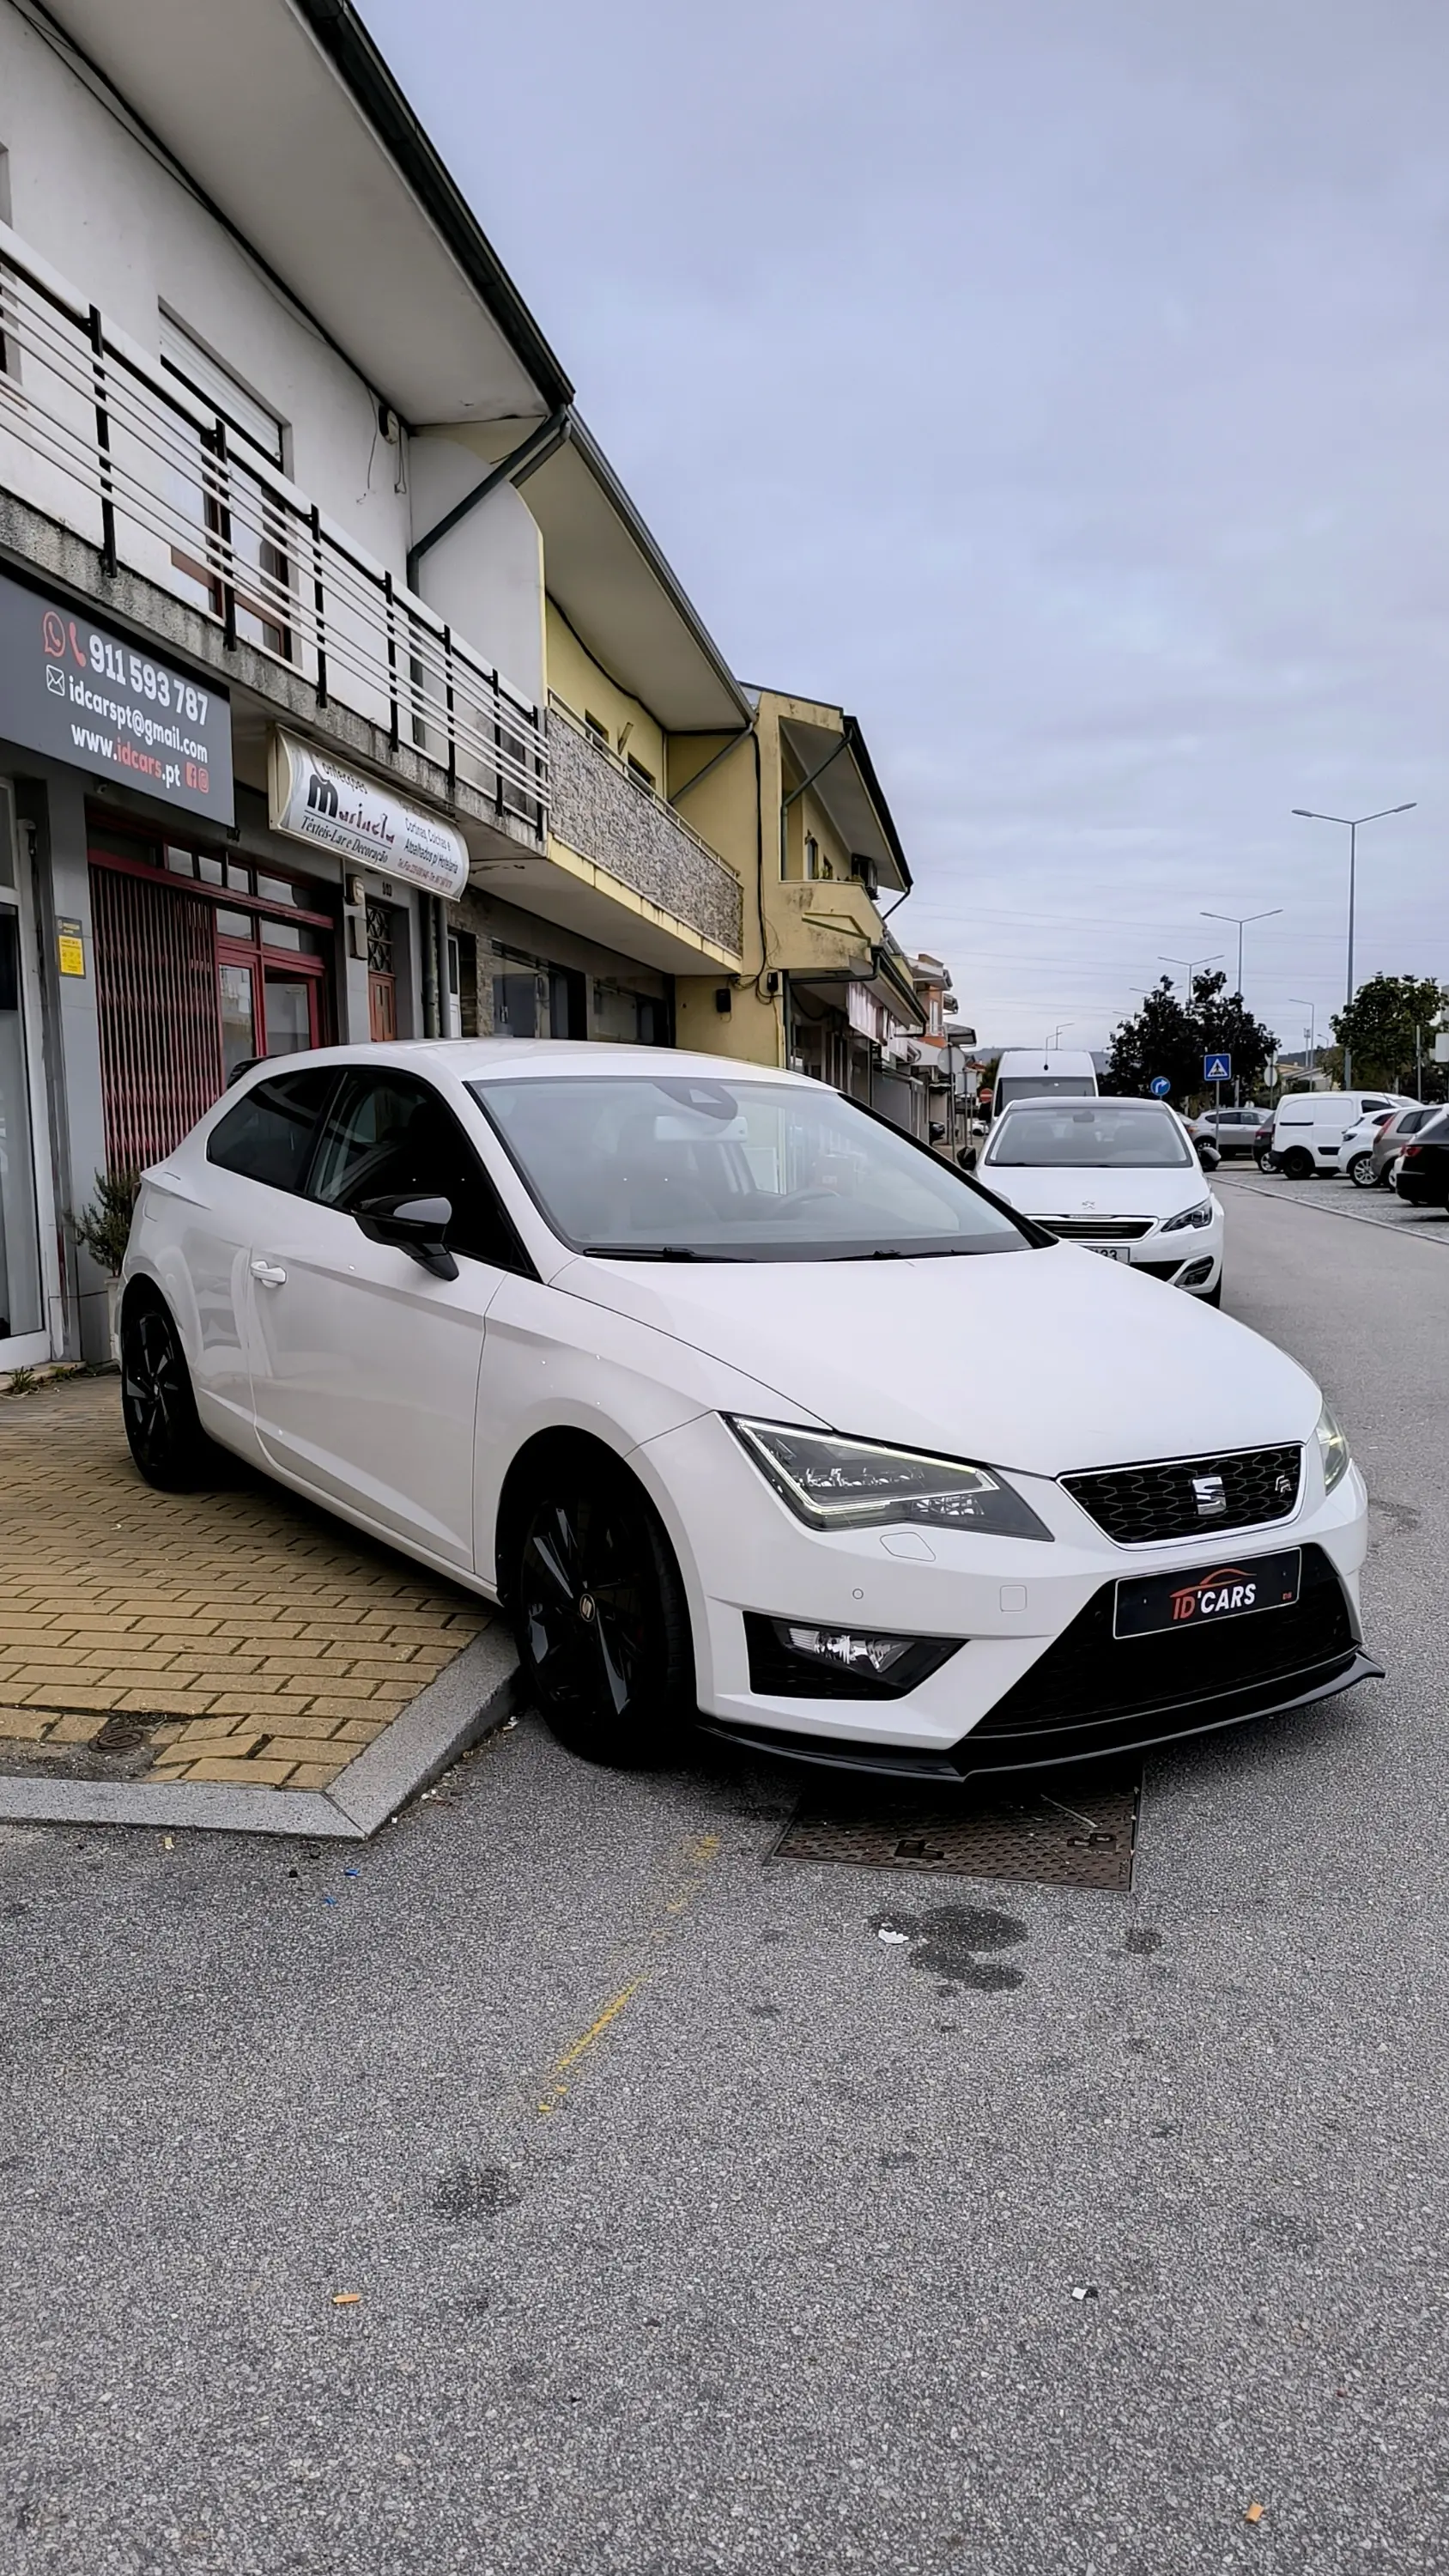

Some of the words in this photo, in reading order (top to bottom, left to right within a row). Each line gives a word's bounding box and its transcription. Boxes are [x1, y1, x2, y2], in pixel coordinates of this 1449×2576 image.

[89, 635, 126, 685] 911
[130, 655, 170, 707] 593
[173, 678, 208, 726] 787
[70, 675, 208, 763] idcarspt@gmail.com
[71, 724, 181, 788] www.idcars.pt
[352, 838, 388, 863] Decoração
